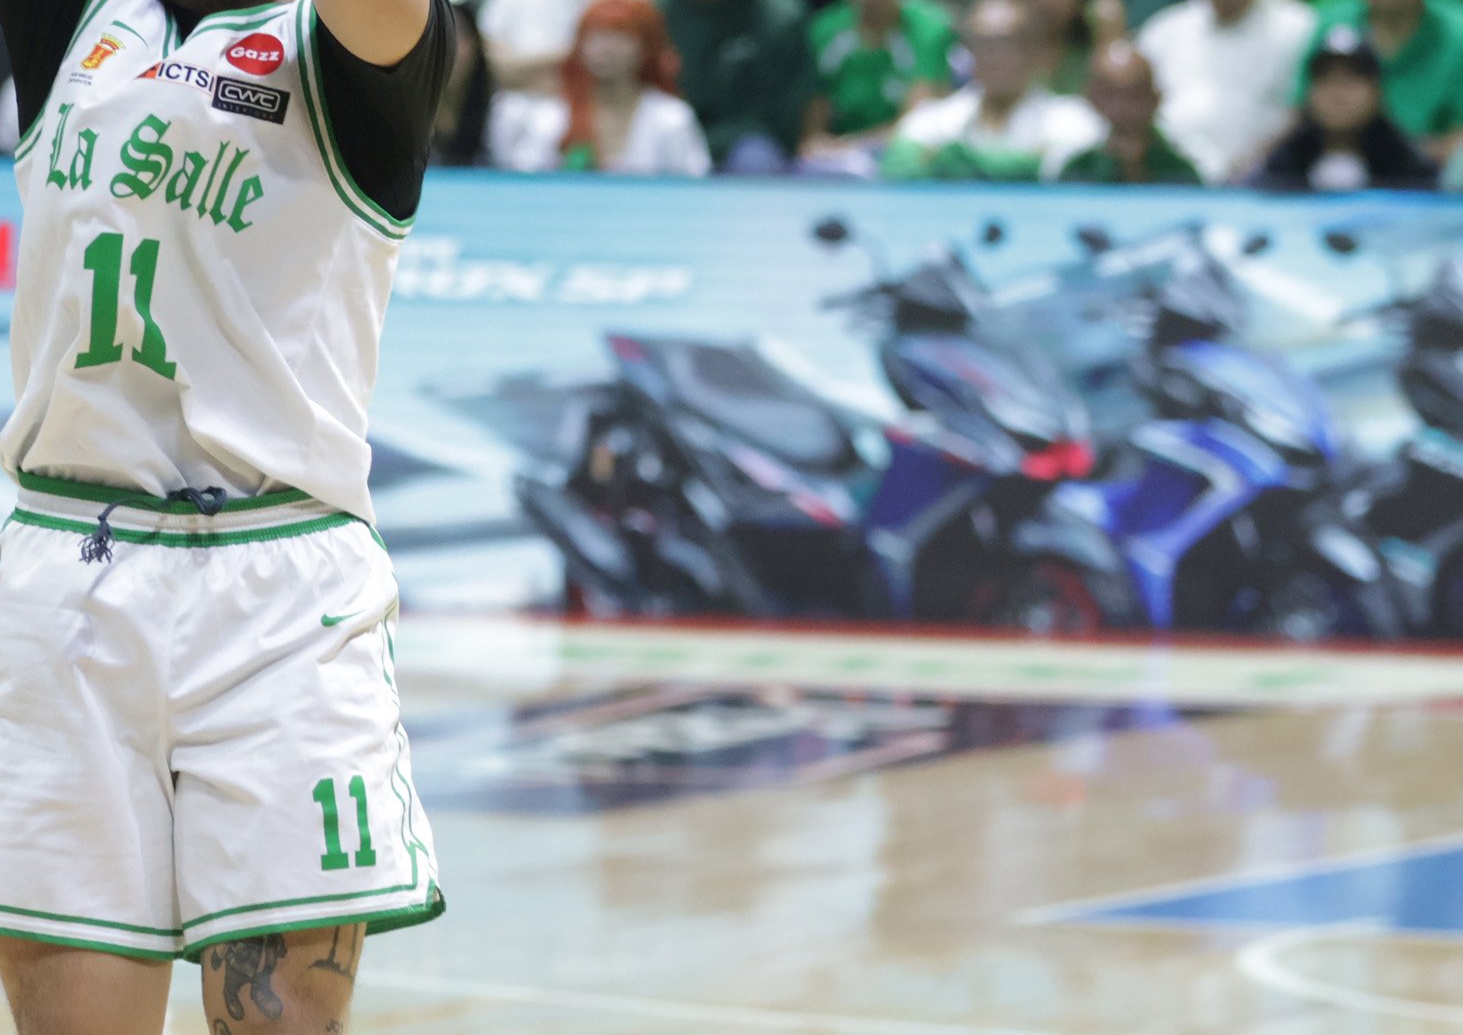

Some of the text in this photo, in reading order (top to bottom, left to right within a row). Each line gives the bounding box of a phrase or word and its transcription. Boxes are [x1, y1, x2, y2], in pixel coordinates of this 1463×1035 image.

[157, 62, 216, 93] ICTSI
[230, 46, 280, 62] Gazz
[224, 85, 275, 108] CWC
[45, 102, 265, 233] La Salle
[73, 232, 178, 382] 11
[312, 774, 377, 871] 11
